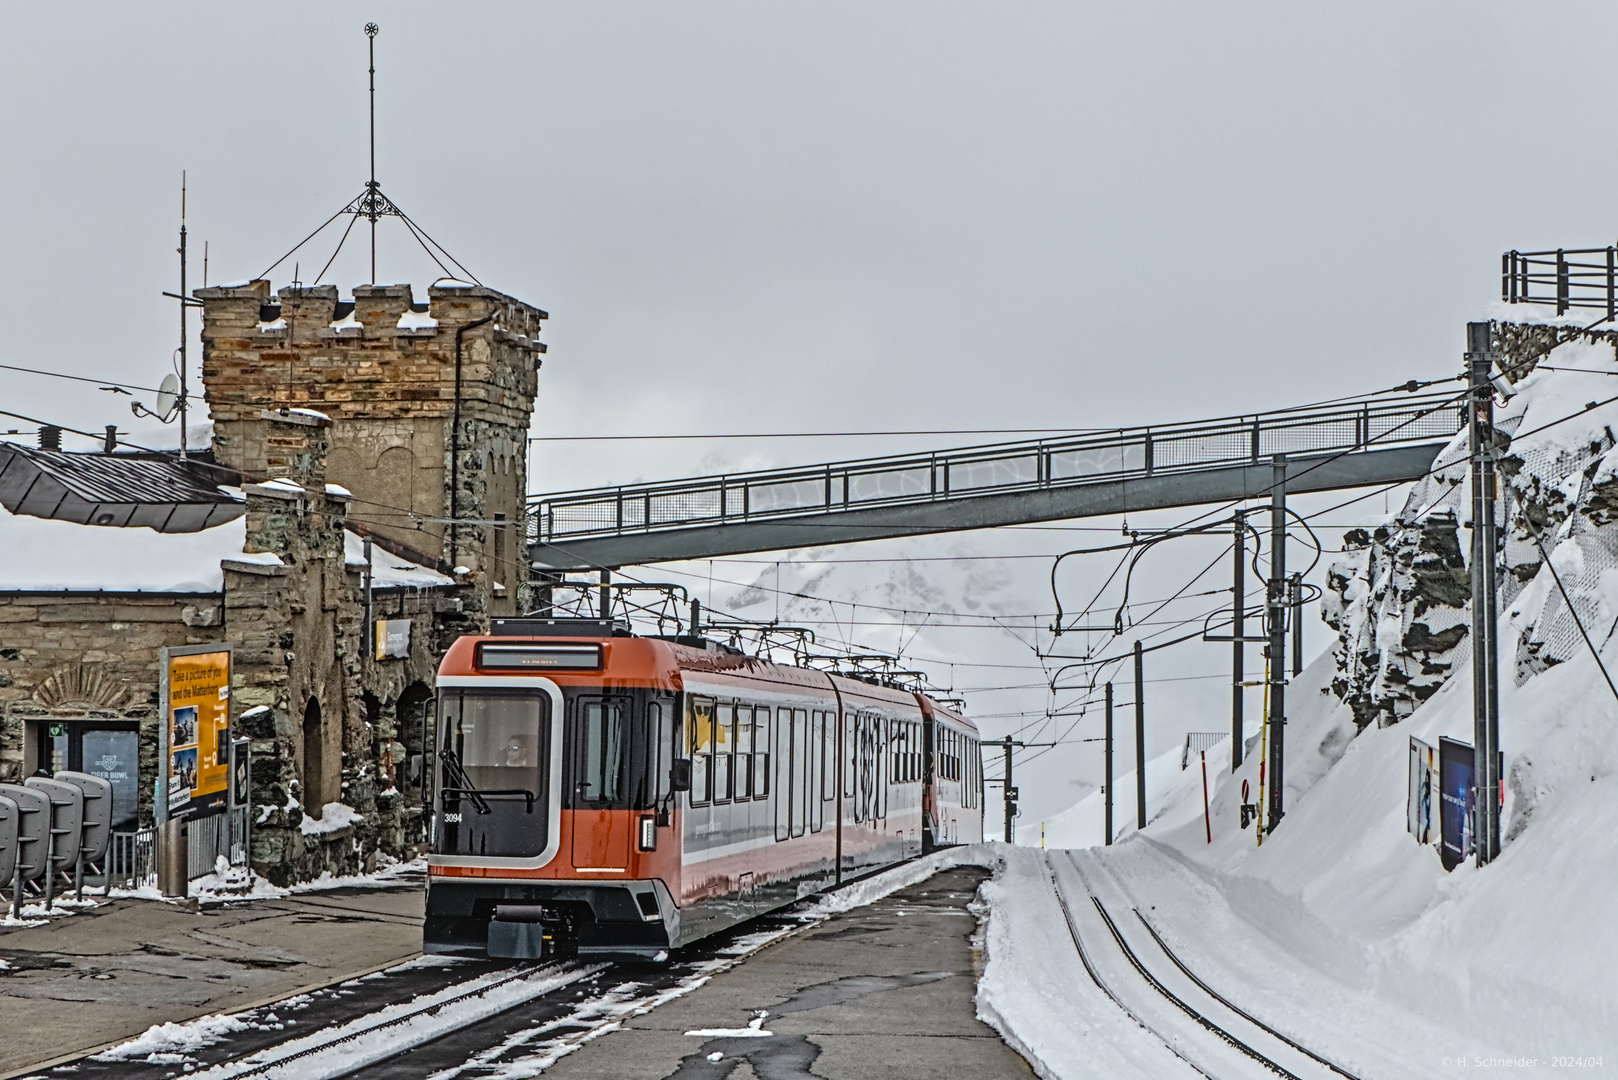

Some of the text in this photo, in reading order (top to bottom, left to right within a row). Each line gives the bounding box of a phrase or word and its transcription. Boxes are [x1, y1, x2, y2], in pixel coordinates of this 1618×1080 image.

[173, 670, 185, 682] Take
[190, 668, 206, 683] picture
[207, 665, 212, 679] of
[212, 668, 222, 680] you
[172, 684, 218, 700] and the Matterhorn
[444, 813, 462, 823] 3094
